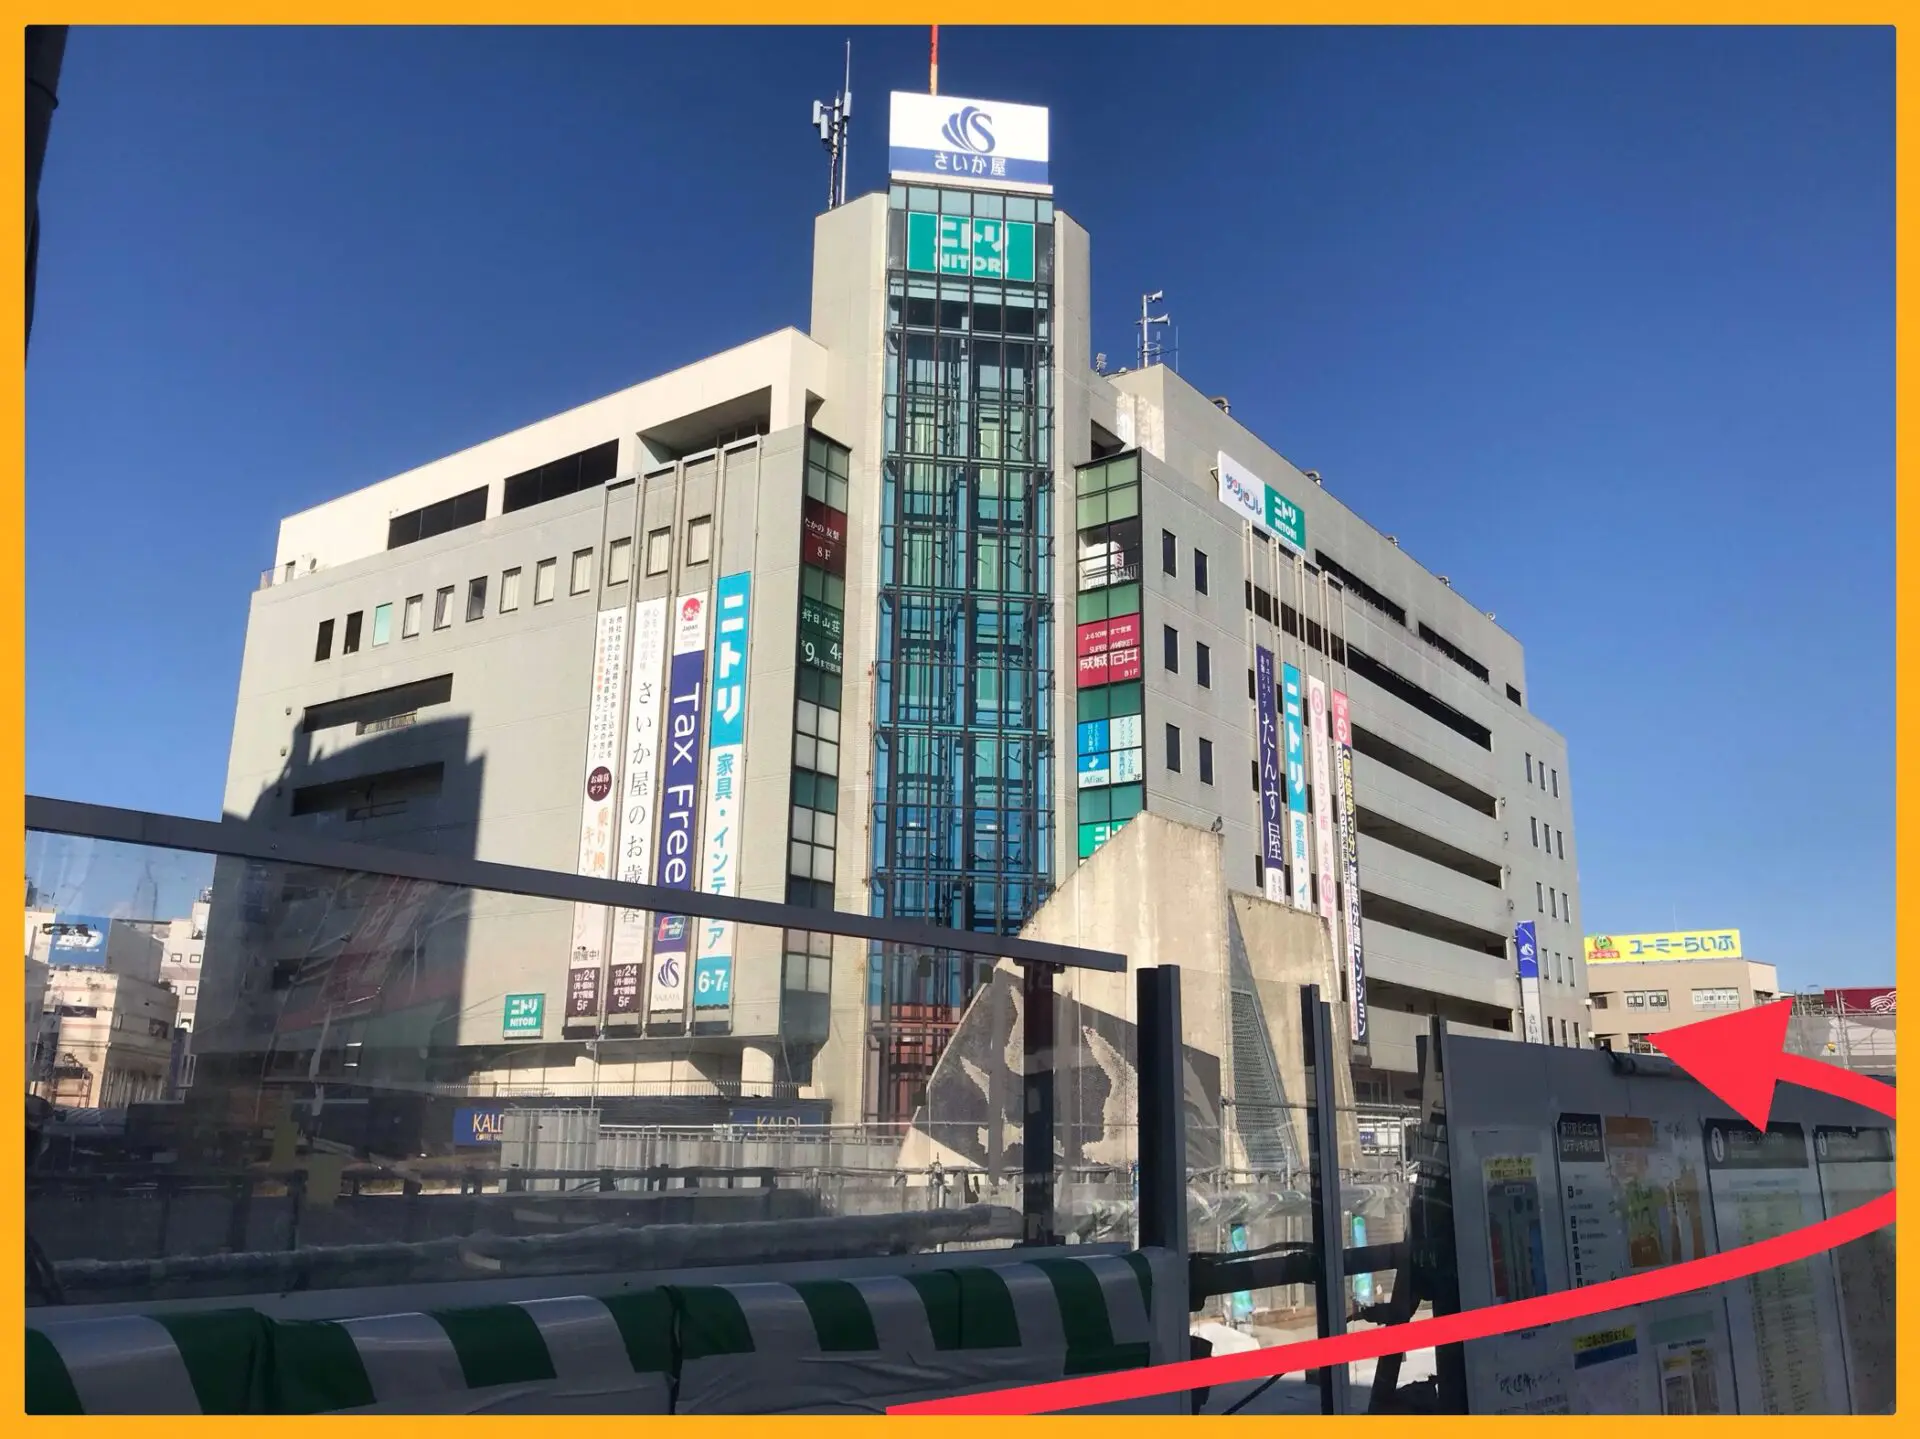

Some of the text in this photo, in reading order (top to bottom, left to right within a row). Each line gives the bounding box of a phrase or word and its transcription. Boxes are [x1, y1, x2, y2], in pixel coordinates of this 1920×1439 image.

[934, 152, 1007, 177] さいか屋
[934, 220, 1010, 253] ニトリ
[933, 252, 1010, 274] NITORI
[1274, 496, 1297, 526] ニトリ
[1274, 518, 1298, 541] NITORI
[816, 545, 832, 561] 8F
[802, 608, 841, 634] 好日山荘
[1084, 624, 1132, 641] よる10時まで営業
[1110, 638, 1134, 650] MARKET
[716, 594, 745, 725] ニトリ
[1079, 648, 1139, 671] 成城石井
[672, 682, 701, 766] Tax
[1286, 682, 1305, 796] ニトリ
[1083, 775, 1105, 786] Aflac
[1261, 711, 1283, 862] たんす屋
[664, 783, 694, 885] Free
[1094, 823, 1124, 842] ニト
[707, 753, 735, 950] 家具・インテア
[1628, 934, 1736, 955] ユーミーらいふ
[574, 968, 595, 981] 12/24
[615, 965, 638, 977] 12/24
[511, 998, 538, 1015] ニトリ
[576, 999, 590, 1012] 5F
[617, 995, 631, 1009] 5F
[510, 1015, 537, 1027] NITORI
